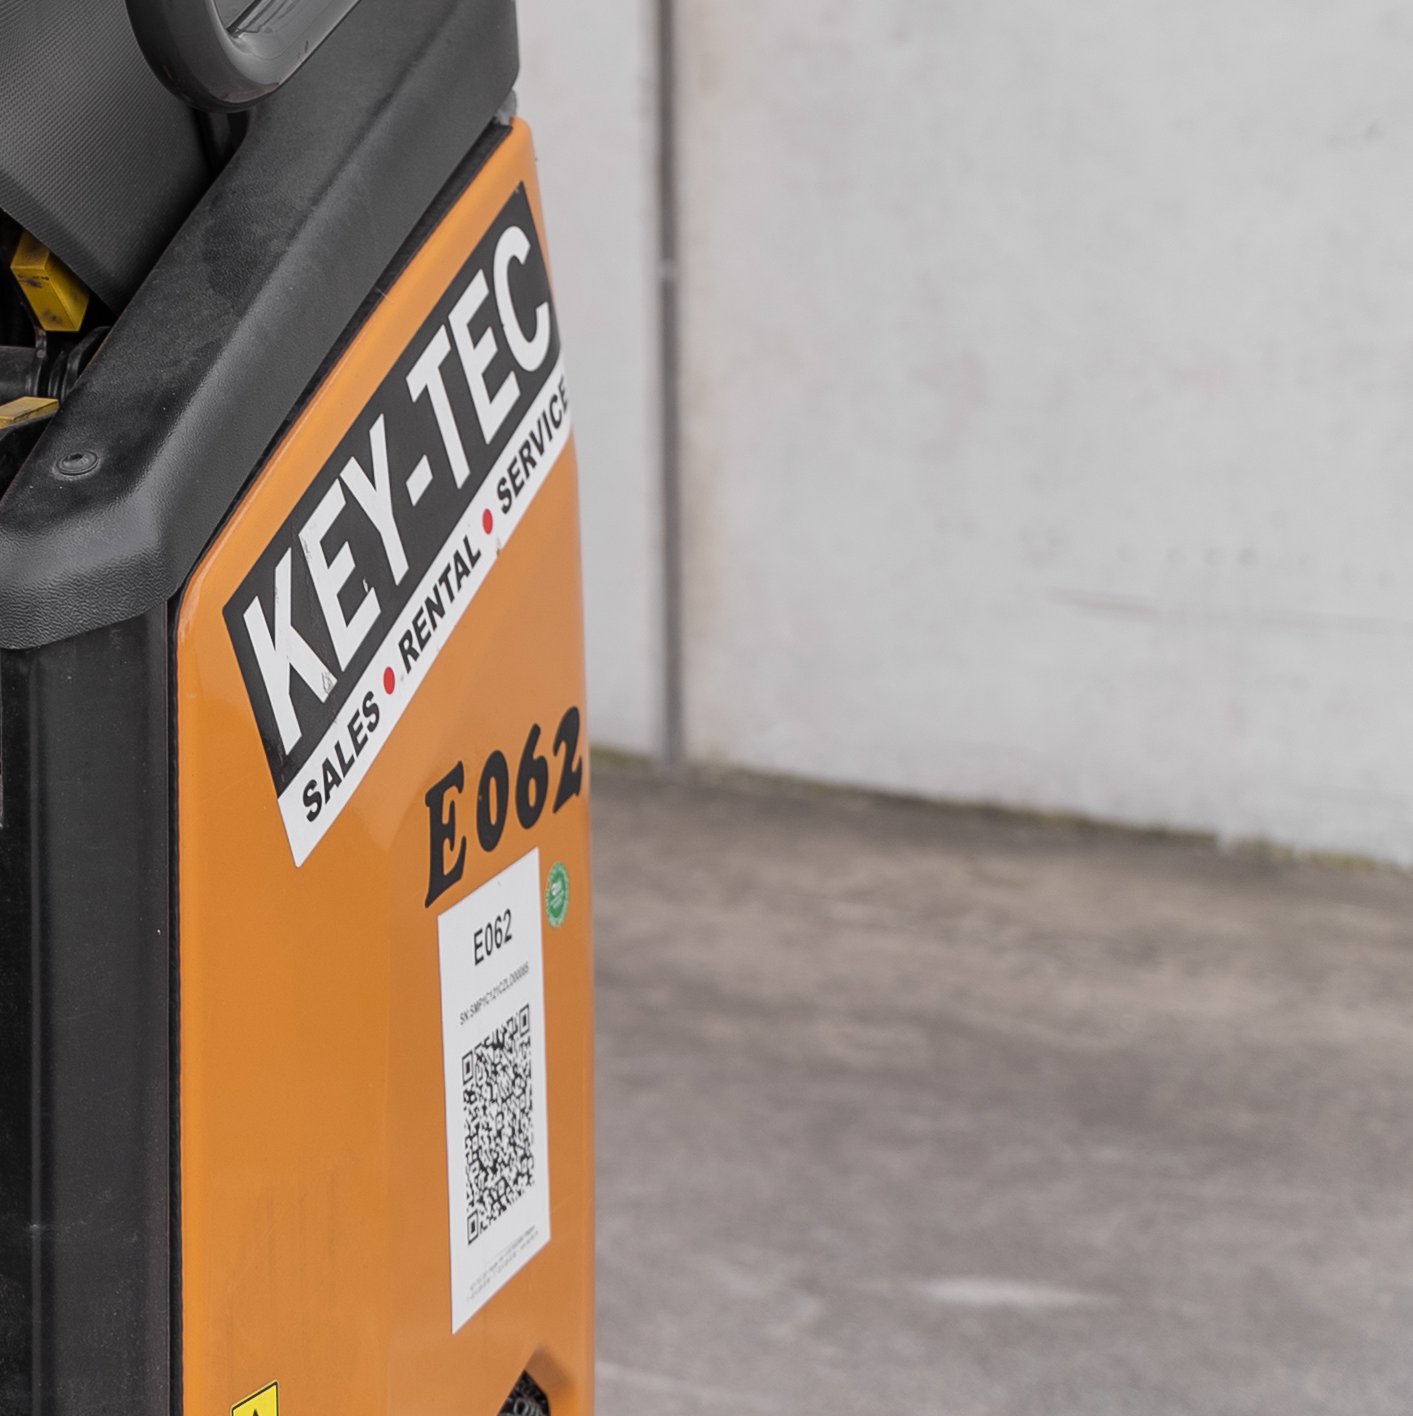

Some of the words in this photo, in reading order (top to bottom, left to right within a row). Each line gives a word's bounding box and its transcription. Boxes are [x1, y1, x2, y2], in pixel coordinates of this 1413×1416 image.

[243, 226, 552, 754] KEY-TEC
[302, 691, 381, 823] SALES
[399, 534, 482, 675] RENTAL
[496, 375, 570, 516] SERVICE
[424, 705, 583, 908] E062
[474, 908, 512, 966] E062
